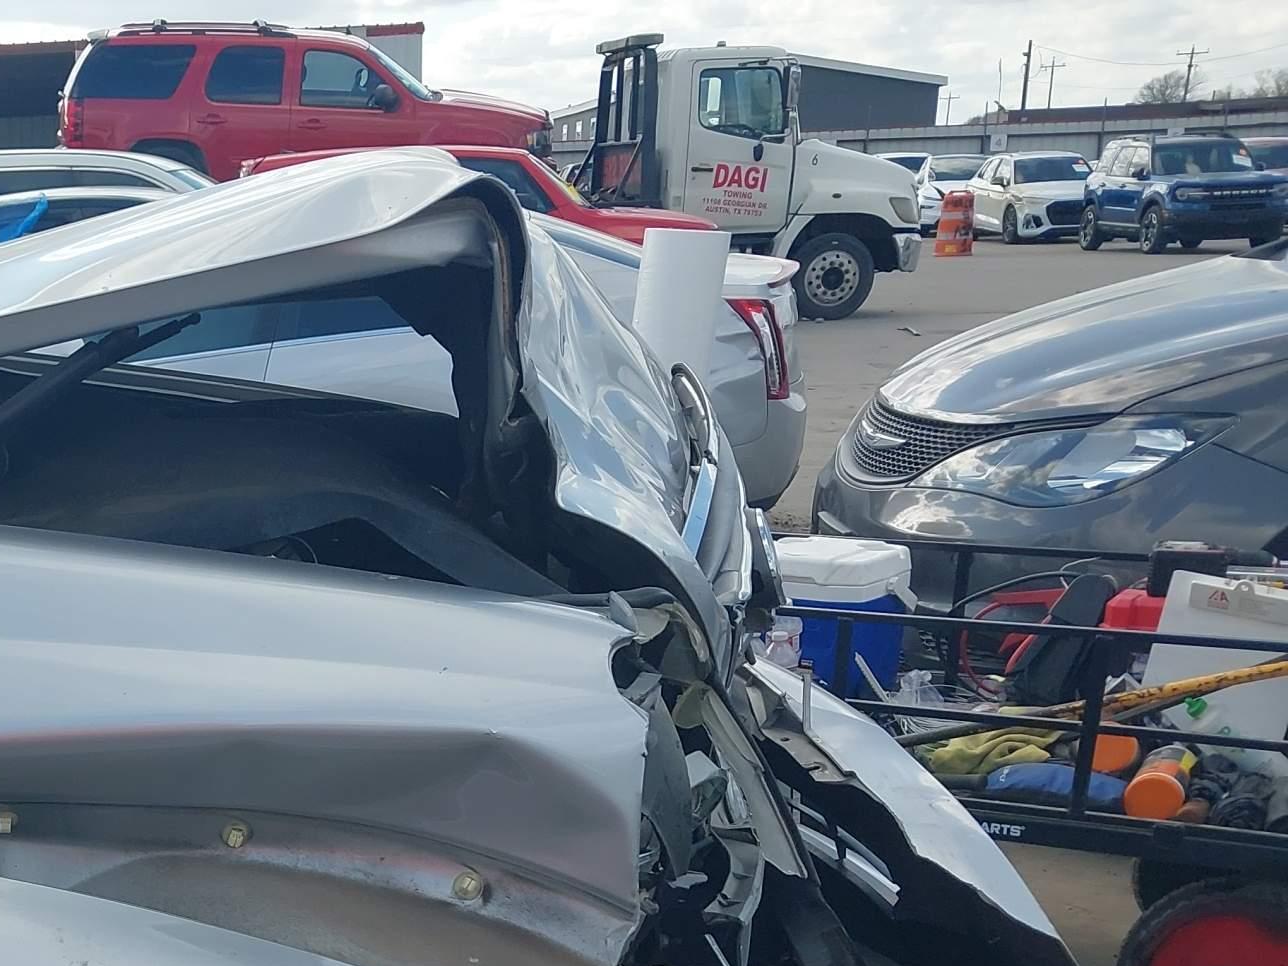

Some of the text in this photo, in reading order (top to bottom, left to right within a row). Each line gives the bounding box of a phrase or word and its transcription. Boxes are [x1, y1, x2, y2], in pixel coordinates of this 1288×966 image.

[811, 153, 819, 166] 6
[713, 164, 768, 192] DAGI
[723, 190, 753, 200] TOWING
[722, 199, 756, 208] GEORGIAN
